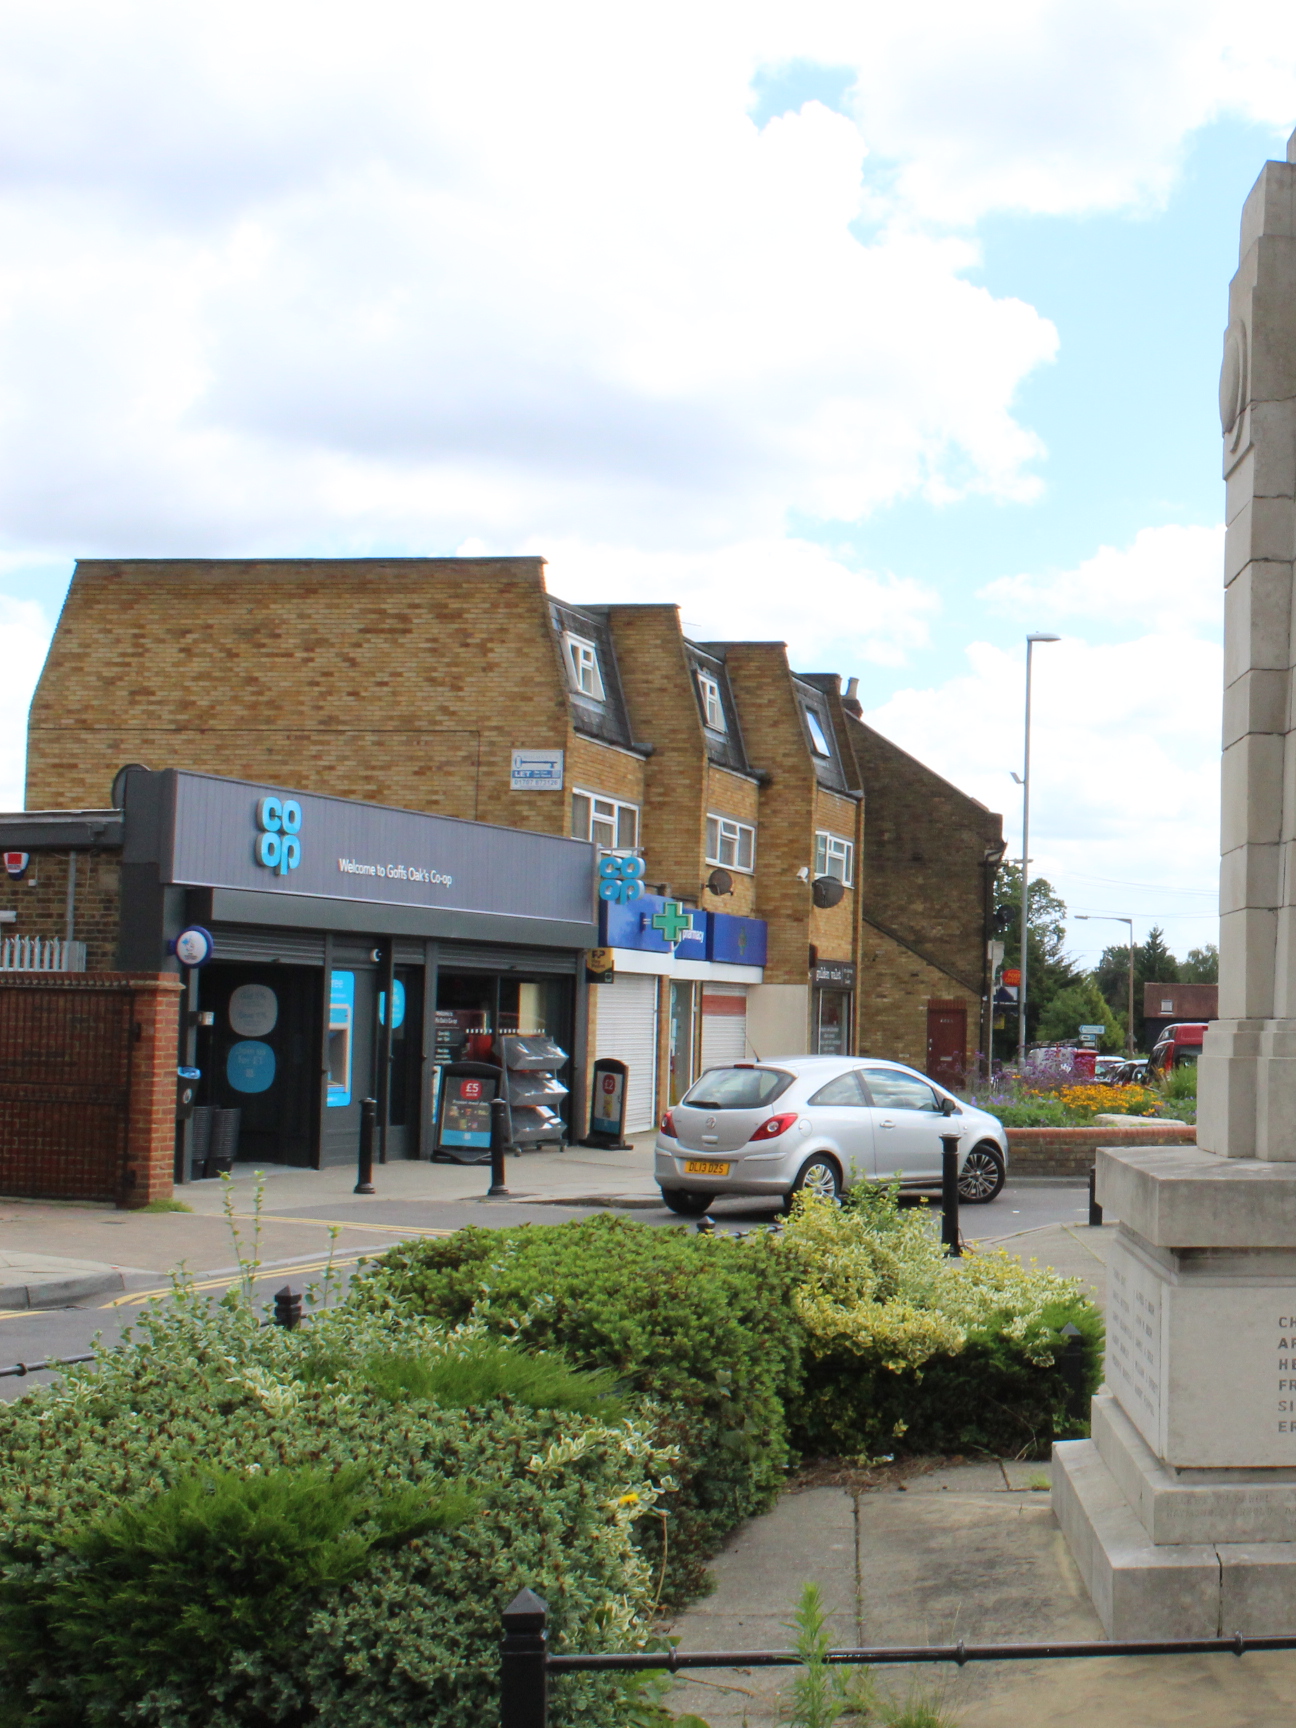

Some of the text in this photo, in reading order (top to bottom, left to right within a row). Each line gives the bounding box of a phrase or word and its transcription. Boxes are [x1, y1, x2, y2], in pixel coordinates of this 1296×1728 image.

[514, 770, 531, 778] LET
[338, 858, 452, 888] Welcome to Goffs Oak's Co-op
[465, 1082, 479, 1092] £5
[689, 1162, 724, 1174] DL13 DZS
